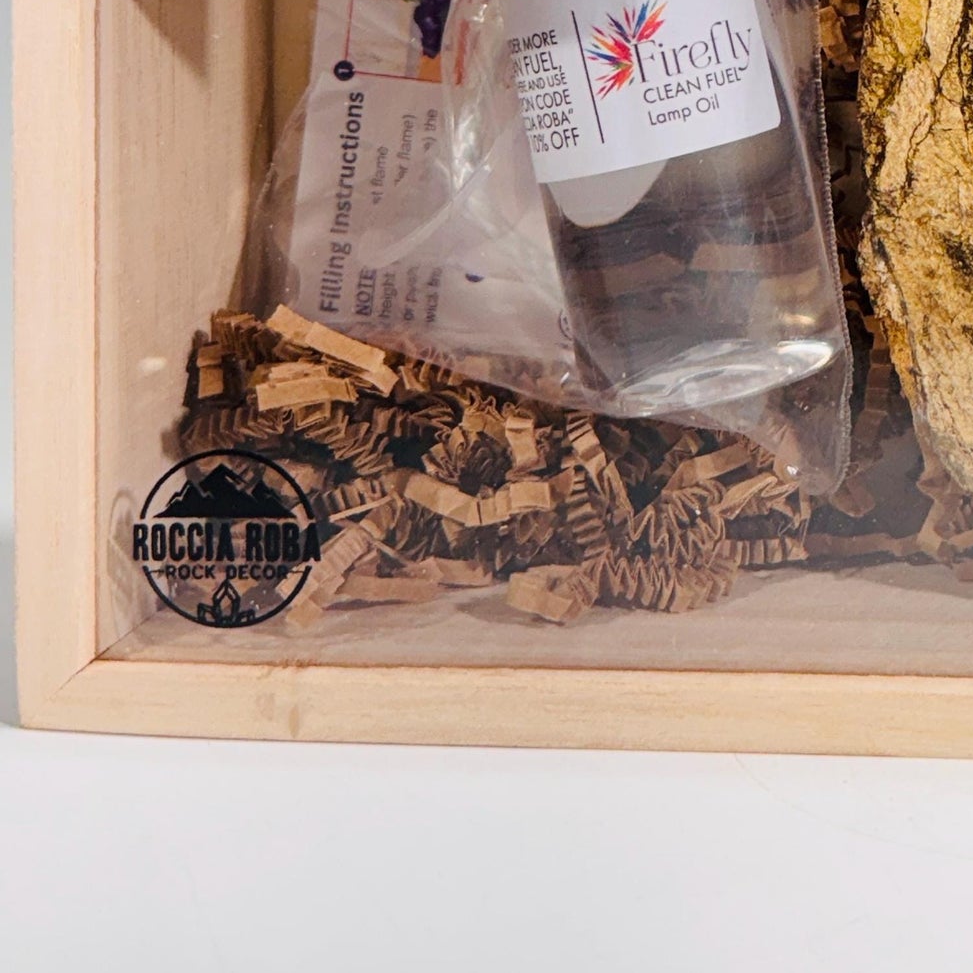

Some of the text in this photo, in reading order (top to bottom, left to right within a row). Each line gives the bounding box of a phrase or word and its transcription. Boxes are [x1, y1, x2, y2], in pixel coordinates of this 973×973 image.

[522, 29, 558, 51] MORE
[634, 20, 752, 83] Firefly
[523, 51, 562, 75] FUEL,
[528, 77, 545, 91] AND
[547, 72, 568, 88] USE
[643, 67, 741, 104] CLEAN FUEL
[536, 89, 572, 110] CODE
[648, 93, 720, 126] Lamp Oil
[551, 127, 579, 149] OFF
[319, 91, 365, 314] Filling Instructions
[133, 522, 321, 562] ROCCIA ROBA
[165, 565, 288, 580] ROCK DECOR
